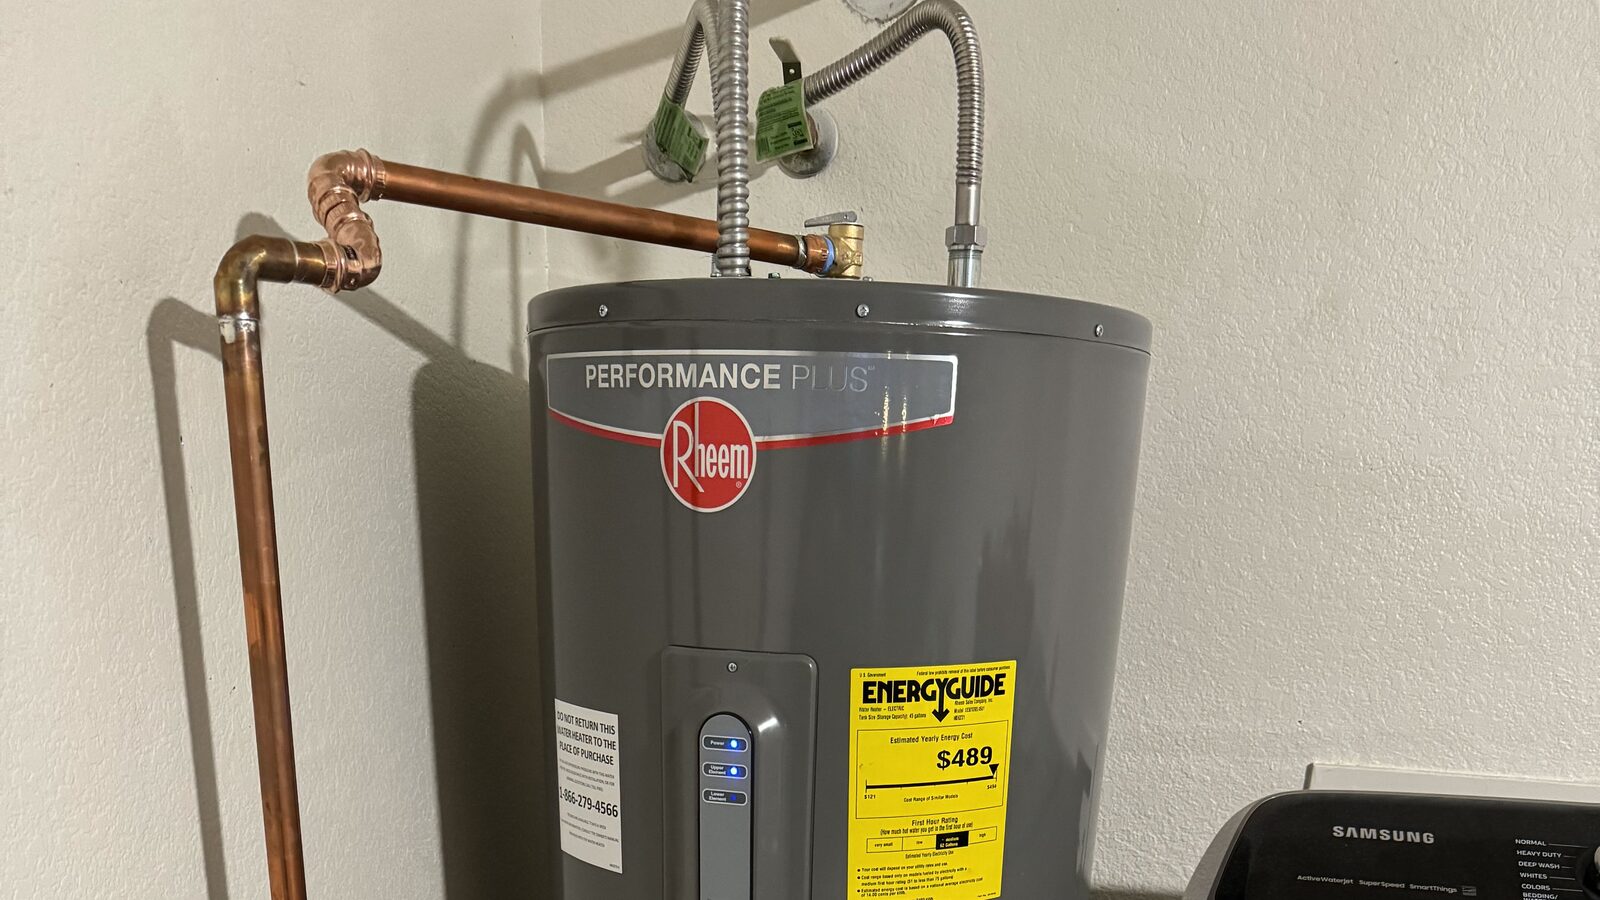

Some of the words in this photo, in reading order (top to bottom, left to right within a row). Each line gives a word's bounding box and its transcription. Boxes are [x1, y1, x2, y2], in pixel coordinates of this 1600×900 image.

[586, 363, 781, 390] PERFORMANCE
[792, 364, 869, 392] PLUS
[672, 402, 748, 493] Rheem
[862, 673, 1006, 704] ENERGYGUIDE
[557, 710, 563, 721] DO
[564, 713, 574, 725] NOT
[575, 716, 598, 731] RETURN
[600, 722, 616, 735] THIS
[556, 725, 571, 739] WATER
[572, 731, 593, 745] HEATER
[593, 736, 602, 747] TO
[603, 739, 616, 750] THE
[560, 740, 572, 754] PLACE
[573, 746, 580, 756] OF
[581, 748, 614, 766] PURCHASE
[936, 746, 992, 770] $489
[560, 786, 618, 818] 1-866-279-4566
[1332, 826, 1435, 844] SAMSUNG
[1297, 874, 1353, 885] ActiveWaterjet
[1359, 879, 1405, 889] SuperSpeed
[1409, 883, 1458, 894] SmartThings
